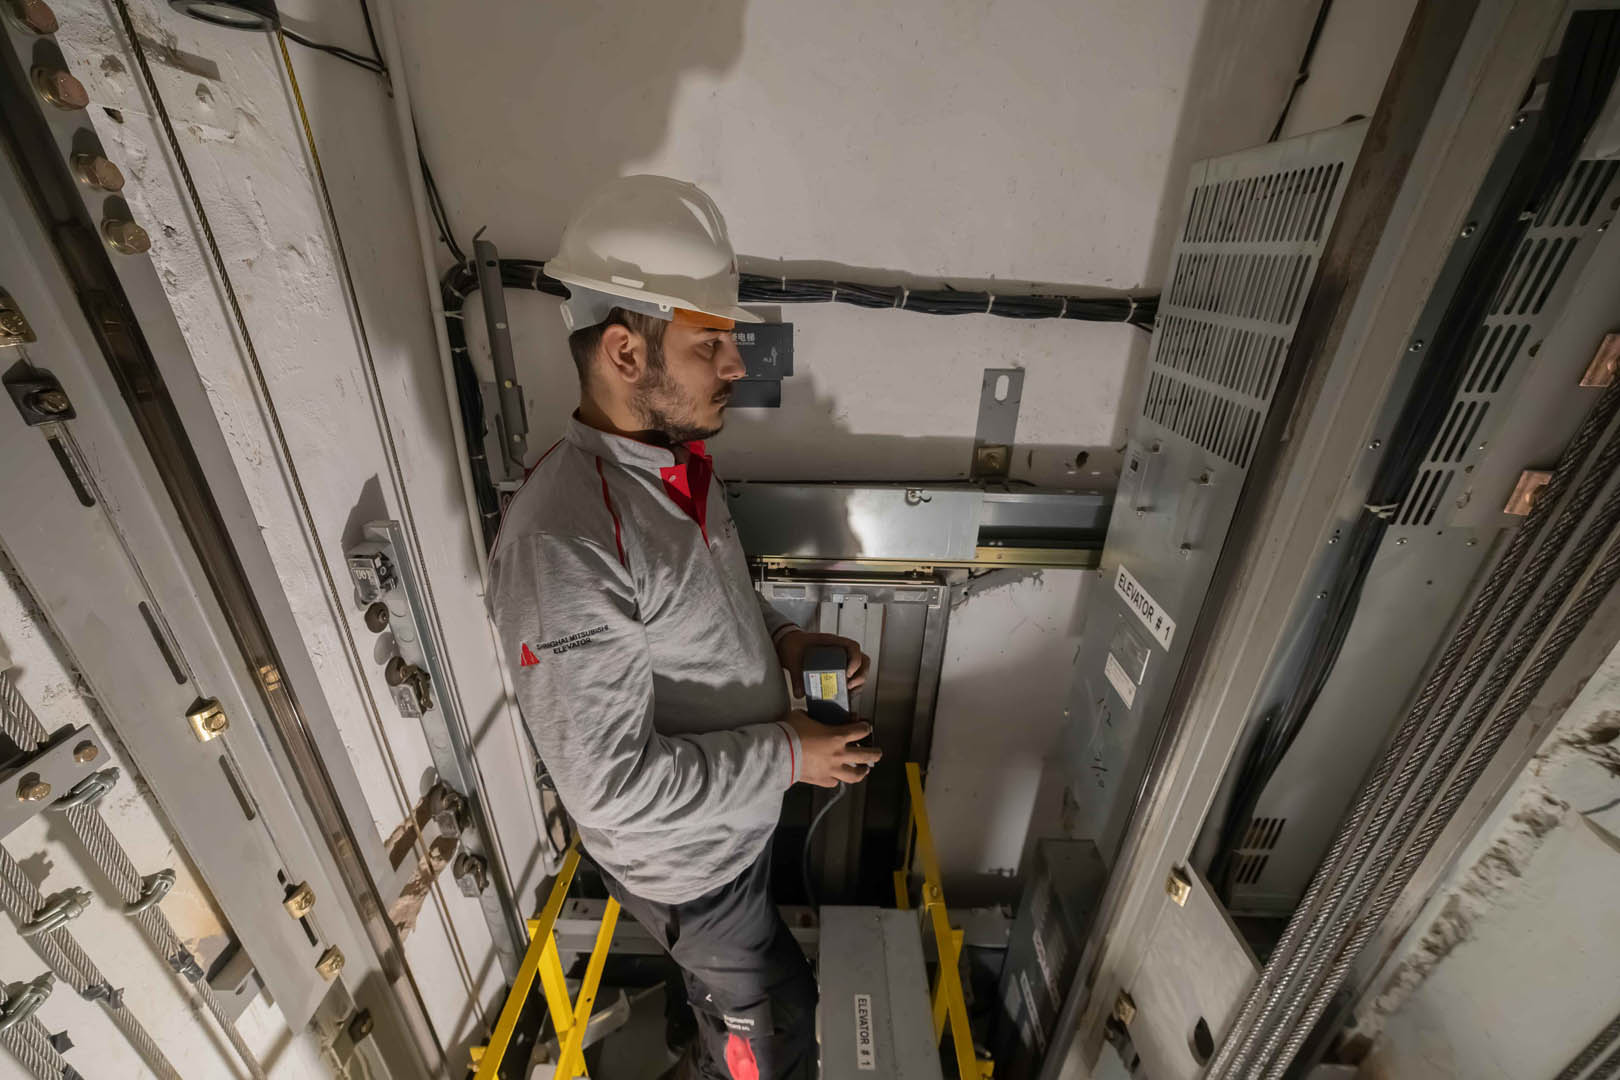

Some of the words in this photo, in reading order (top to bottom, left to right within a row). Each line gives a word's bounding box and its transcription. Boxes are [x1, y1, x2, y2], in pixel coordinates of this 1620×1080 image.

[1118, 573, 1154, 623] ELEVATOR
[1155, 616, 1163, 632] #
[1164, 626, 1171, 641] 1
[553, 637, 592, 654] ELEVATOR
[858, 998, 870, 1045] ELEVATOR
